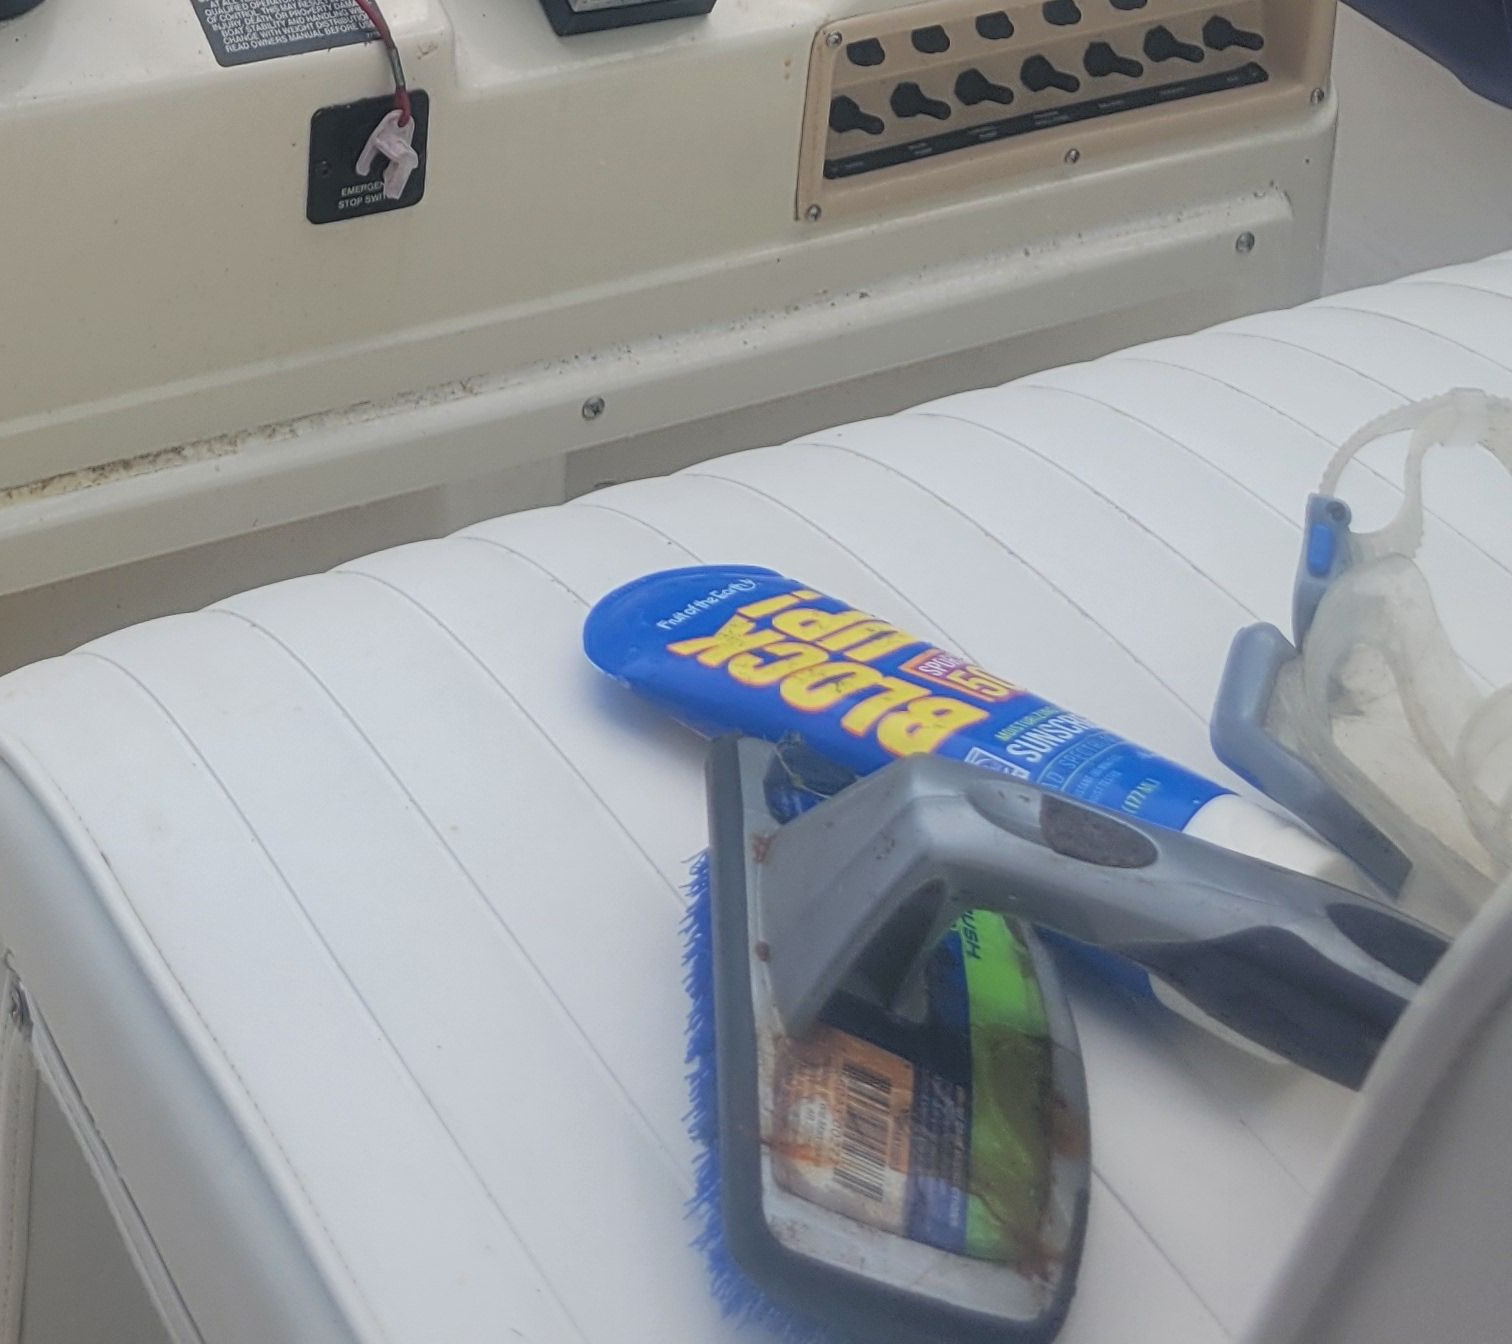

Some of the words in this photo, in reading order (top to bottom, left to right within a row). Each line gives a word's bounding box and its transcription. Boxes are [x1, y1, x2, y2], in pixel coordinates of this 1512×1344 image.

[204, 4, 249, 17] QUALIFIED
[221, 27, 245, 38] BOAT
[245, 20, 286, 33] STABILITY
[224, 41, 250, 53] READ
[337, 198, 363, 210] STOP
[656, 611, 688, 630] Fruit
[693, 596, 719, 610] the
[665, 613, 991, 759] BLOCK
